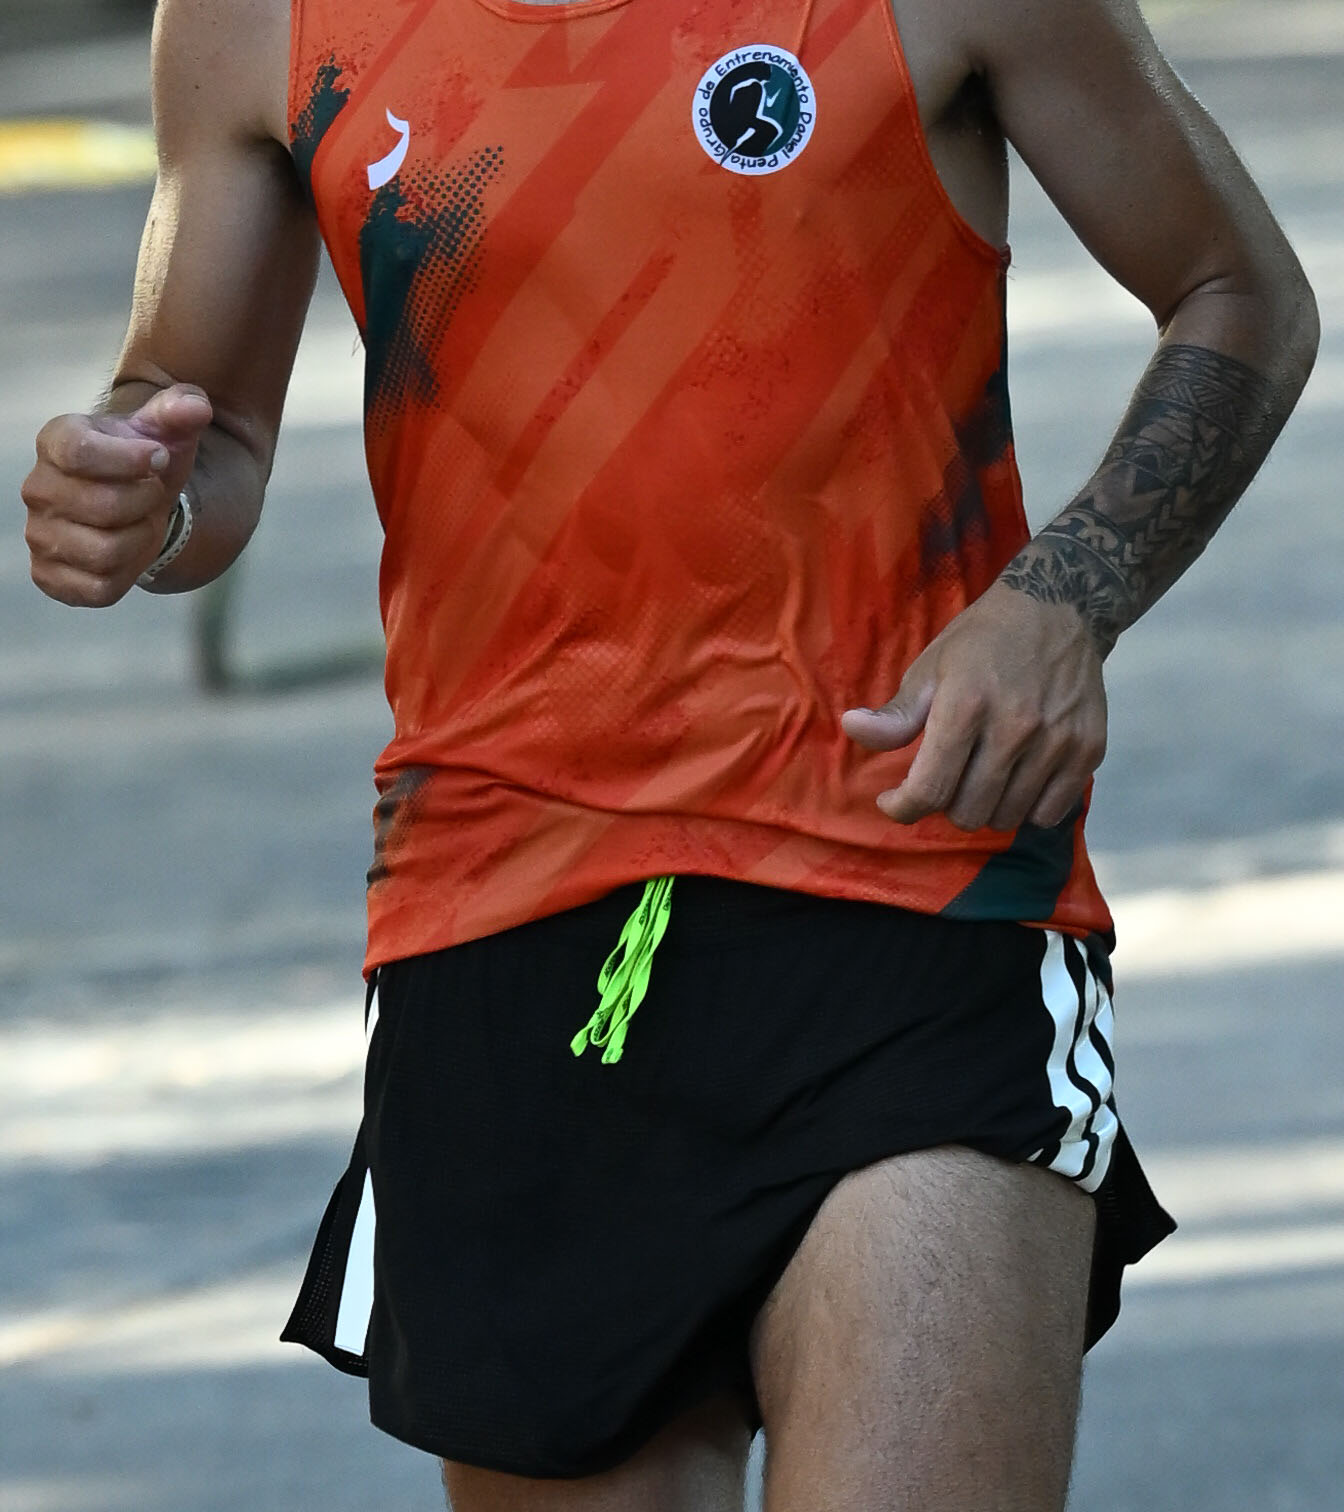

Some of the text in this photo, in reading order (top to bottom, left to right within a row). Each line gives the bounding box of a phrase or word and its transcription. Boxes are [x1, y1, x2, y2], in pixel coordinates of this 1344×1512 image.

[698, 80, 716, 100] de
[698, 107, 726, 157] Grupo
[730, 154, 779, 170] Penta
